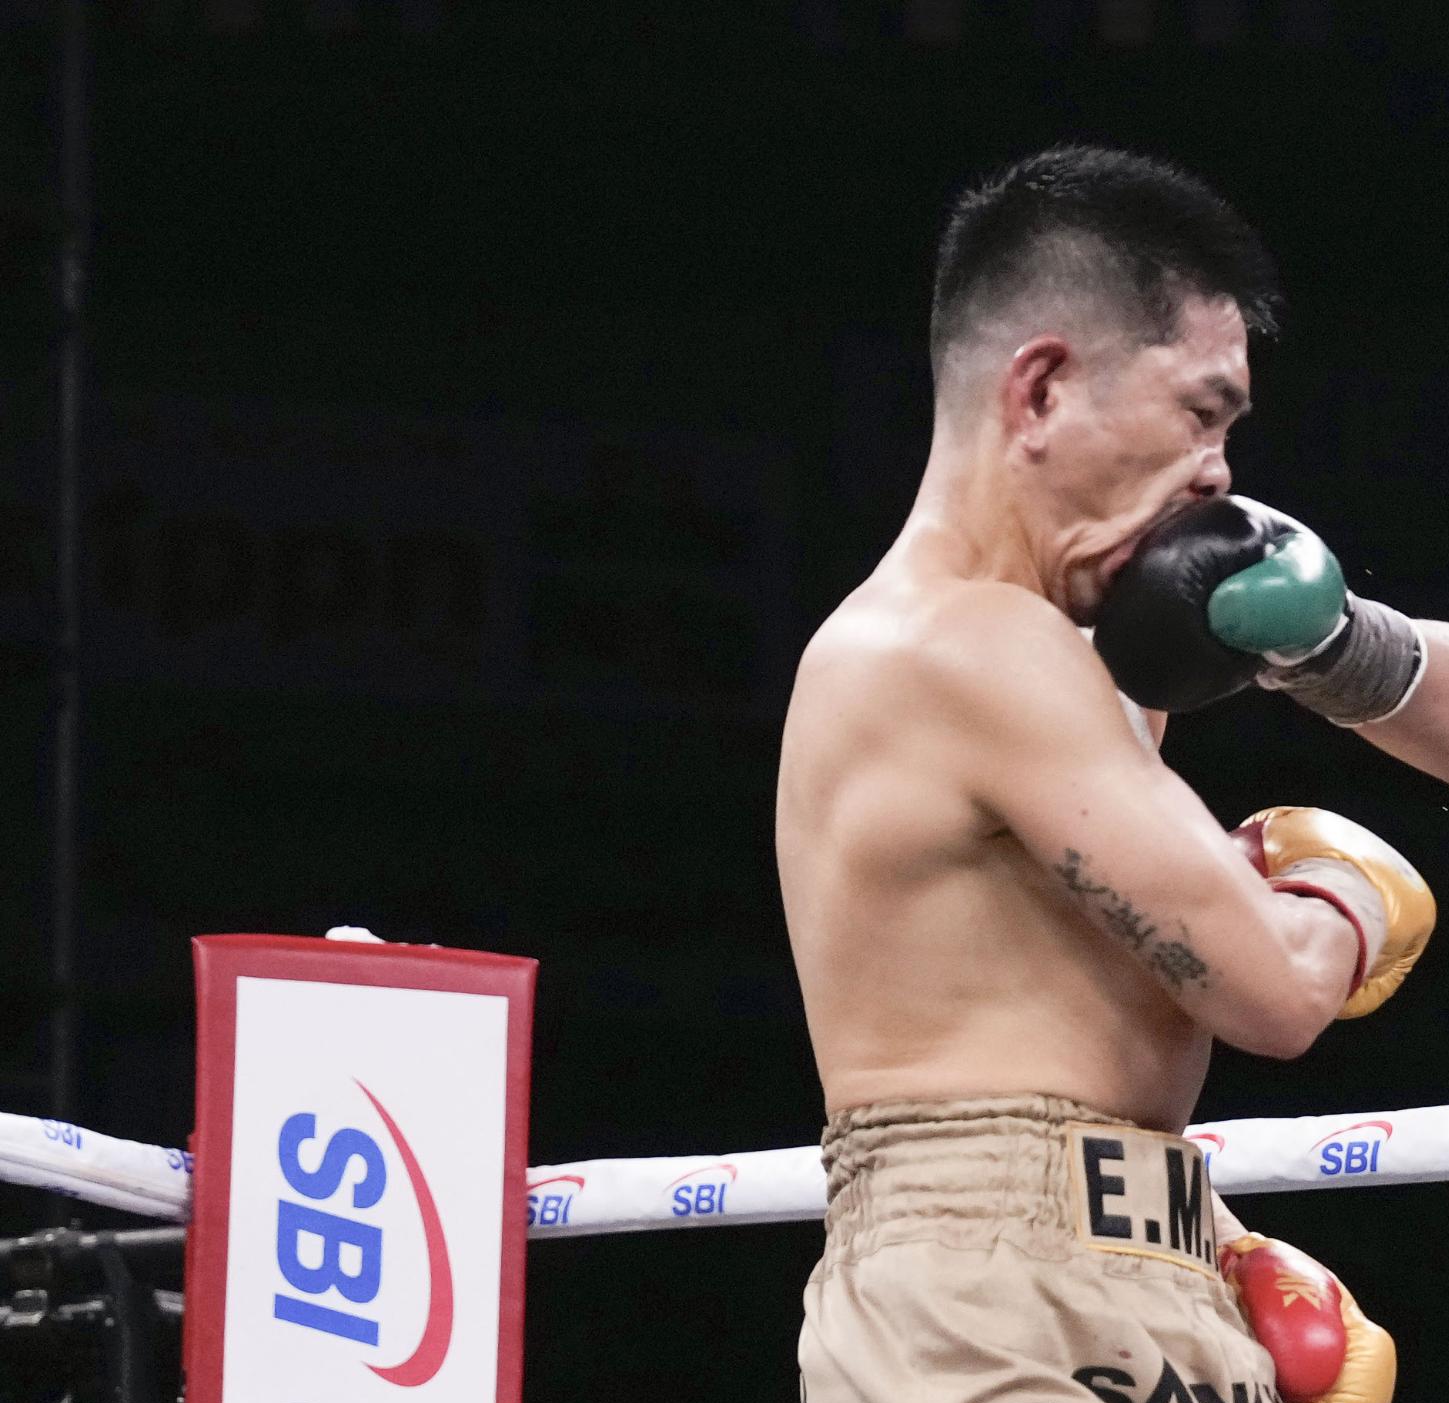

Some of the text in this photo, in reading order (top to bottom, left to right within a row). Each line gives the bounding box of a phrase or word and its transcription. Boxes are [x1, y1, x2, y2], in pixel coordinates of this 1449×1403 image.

[1320, 1139, 1381, 1176] SBI
[672, 1183, 726, 1217] SBI
[273, 1112, 387, 1347] SBI
